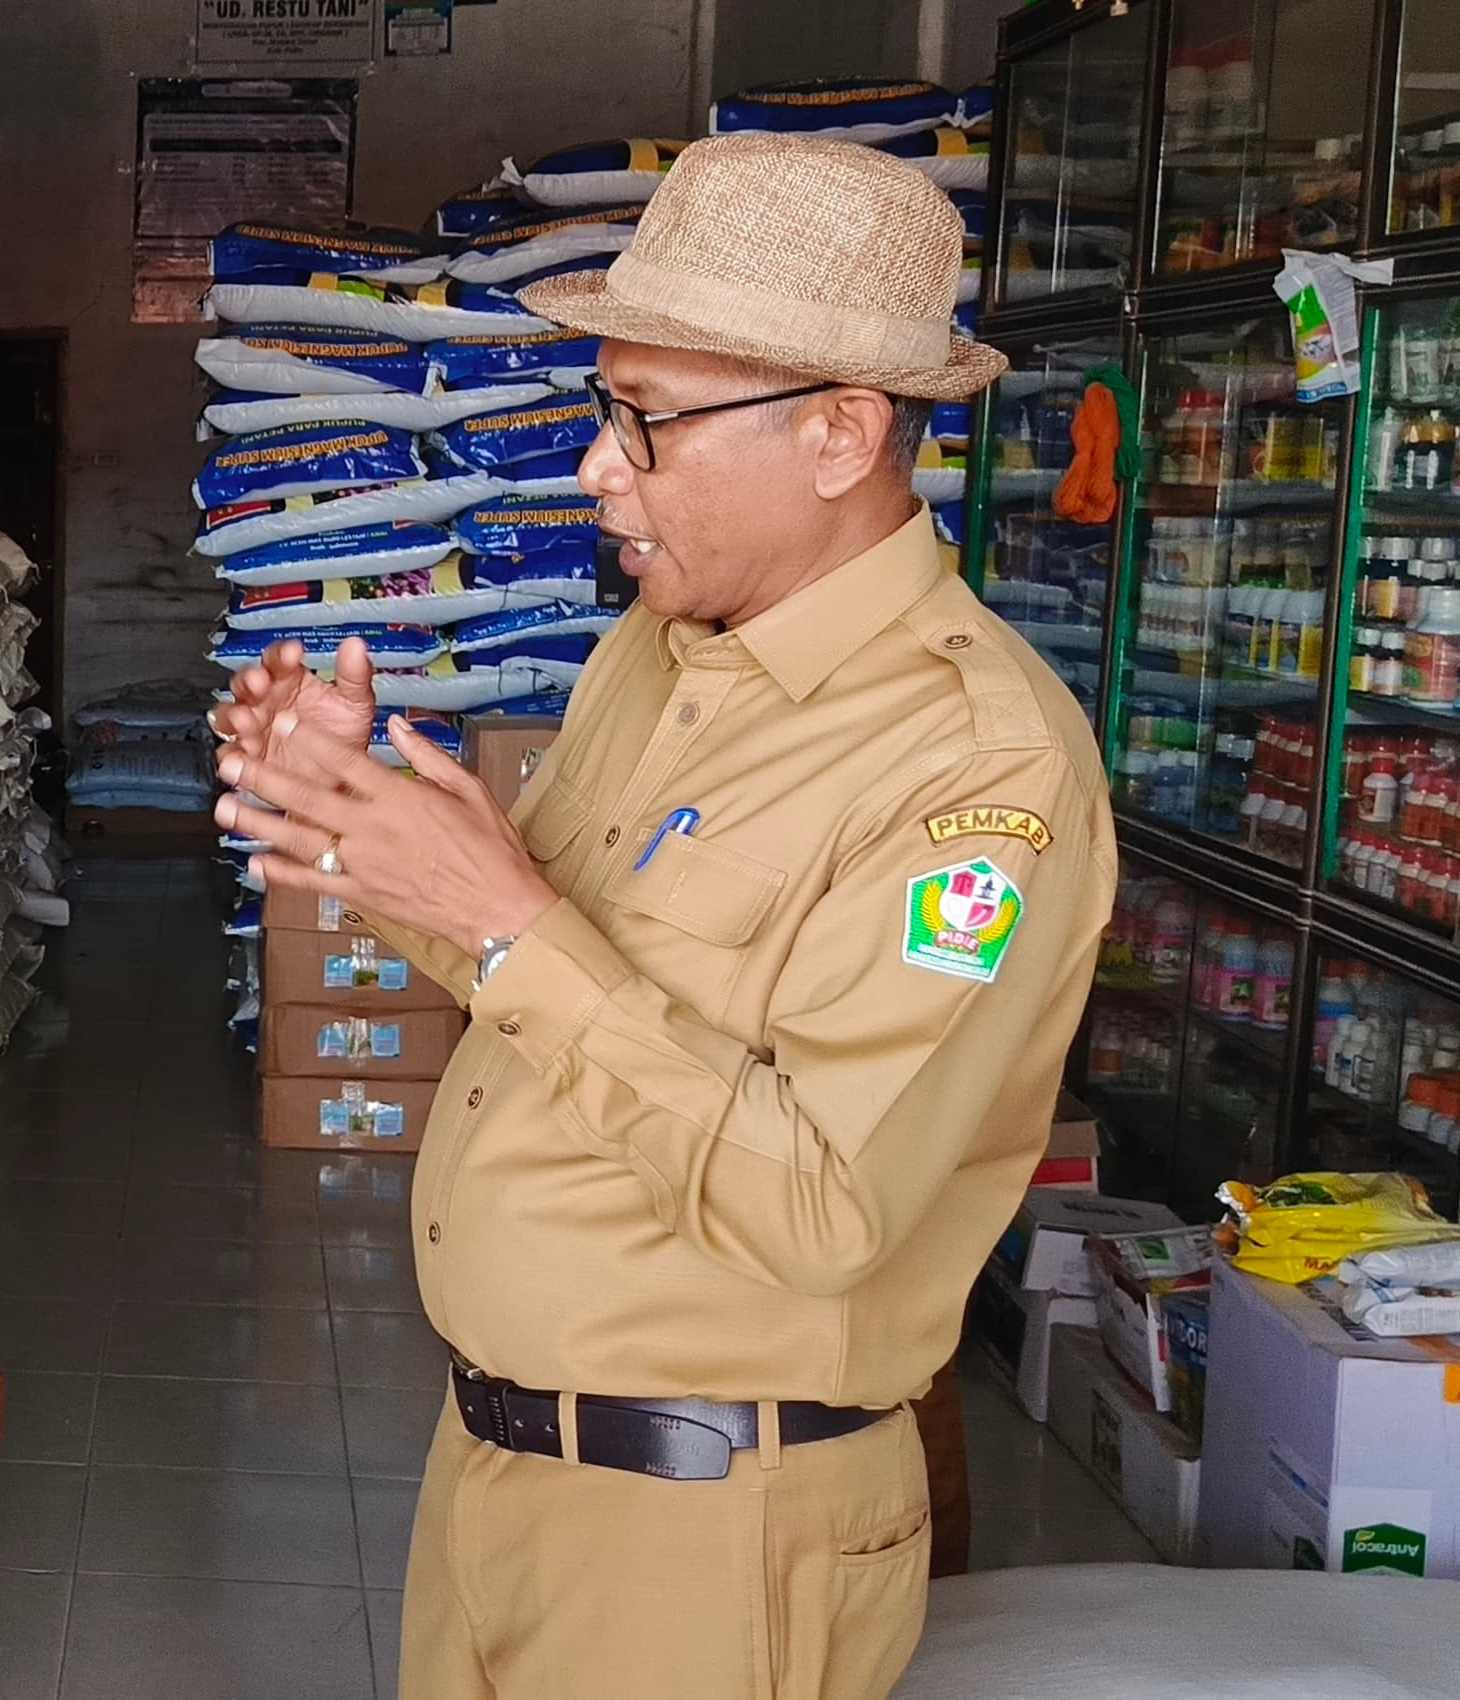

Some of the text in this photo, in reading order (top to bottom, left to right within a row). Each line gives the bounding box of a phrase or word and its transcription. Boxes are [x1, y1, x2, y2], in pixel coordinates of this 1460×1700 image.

[253, 0, 309, 18] RESTU
[287, 421, 319, 432] PARA
[241, 428, 285, 445] PETANI
[521, 508, 598, 525] AGNESIUM
[936, 809, 1045, 845] PEMKAB
[938, 929, 980, 952] PIDIE
[1352, 1541, 1420, 1557] Antracol
